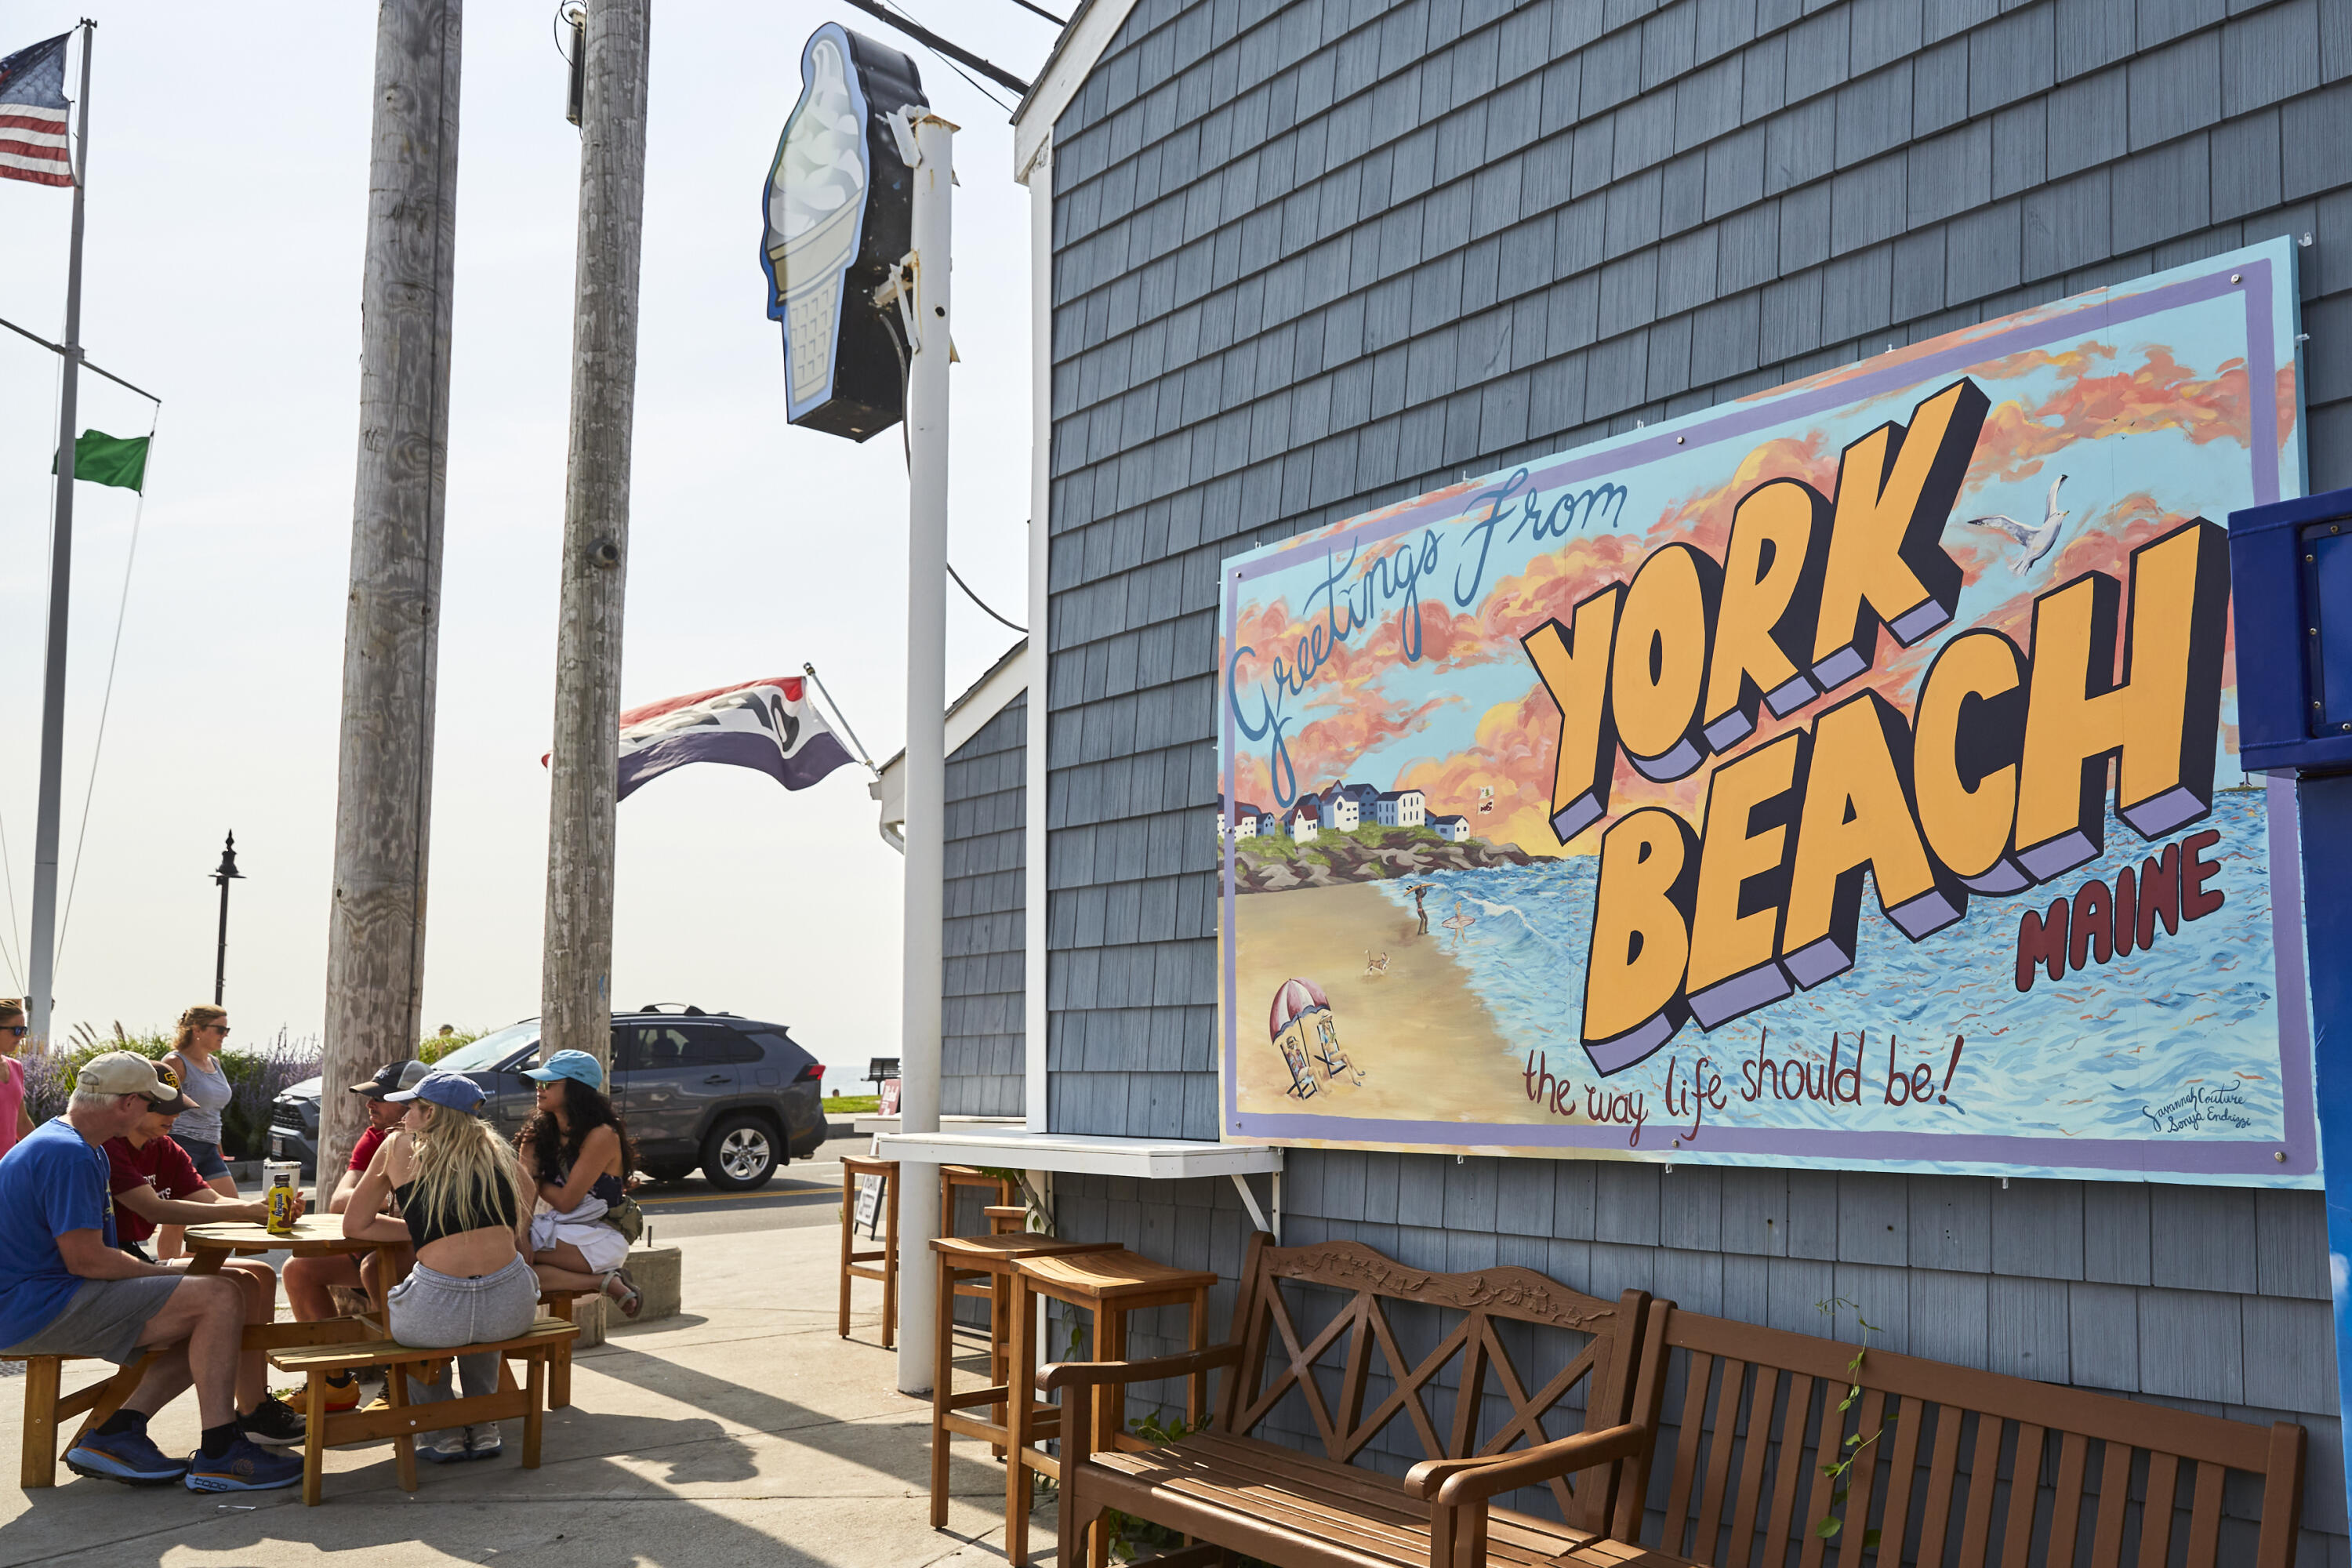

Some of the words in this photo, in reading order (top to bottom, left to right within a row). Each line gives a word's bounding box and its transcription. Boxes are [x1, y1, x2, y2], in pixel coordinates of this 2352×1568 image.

[1229, 528, 1445, 808] Greetings
[1454, 468, 1628, 607] From
[1520, 376, 1991, 845] YORK
[1580, 516, 2231, 1077] BEACH
[2015, 829, 2225, 992] MAINE
[1522, 1049, 1576, 1115] the
[1584, 1083, 1649, 1148] way
[1666, 1056, 1727, 1142] life
[1740, 1026, 1865, 1106] should
[1884, 1034, 1964, 1107] be!
[2142, 1087, 2198, 1132] Savannah
[2198, 1080, 2246, 1105] Couture
[2167, 1111, 2205, 1133] Sonya
[2207, 1106, 2252, 1128] Endrizzi
[194, 1477, 228, 1490] topo
